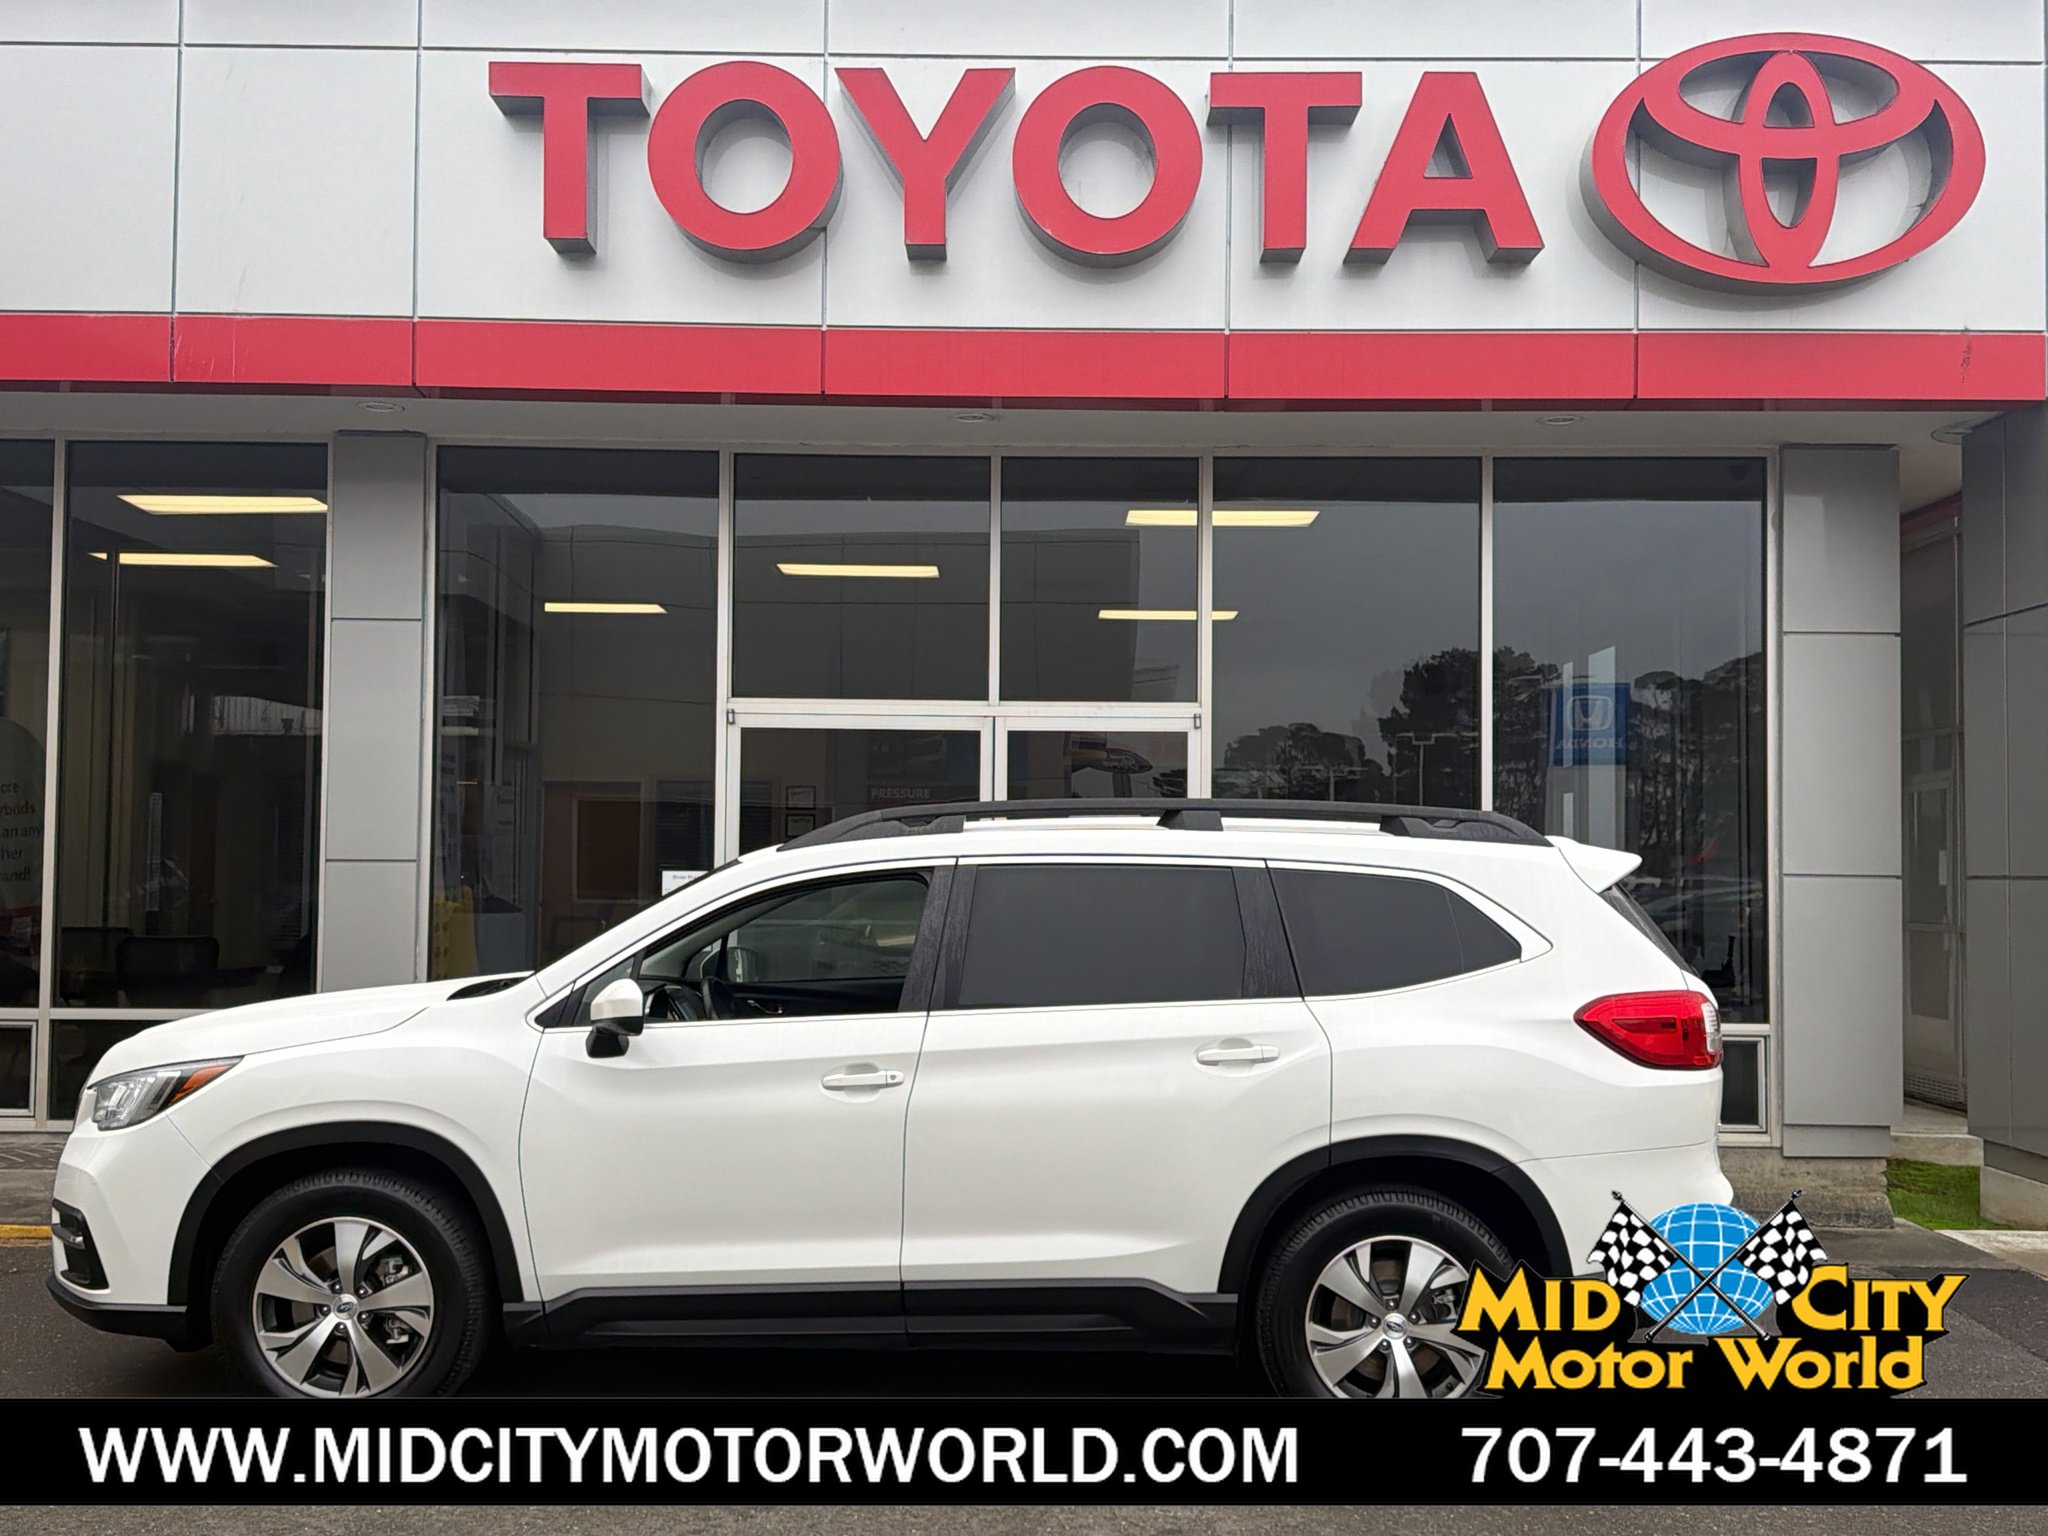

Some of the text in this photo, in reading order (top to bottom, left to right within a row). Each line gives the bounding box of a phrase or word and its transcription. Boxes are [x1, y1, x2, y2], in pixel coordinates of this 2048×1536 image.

[488, 60, 1545, 265] TOYOTA
[0, 781, 20, 794] ore
[870, 787, 932, 800] PRESSURE
[0, 845, 23, 860] her
